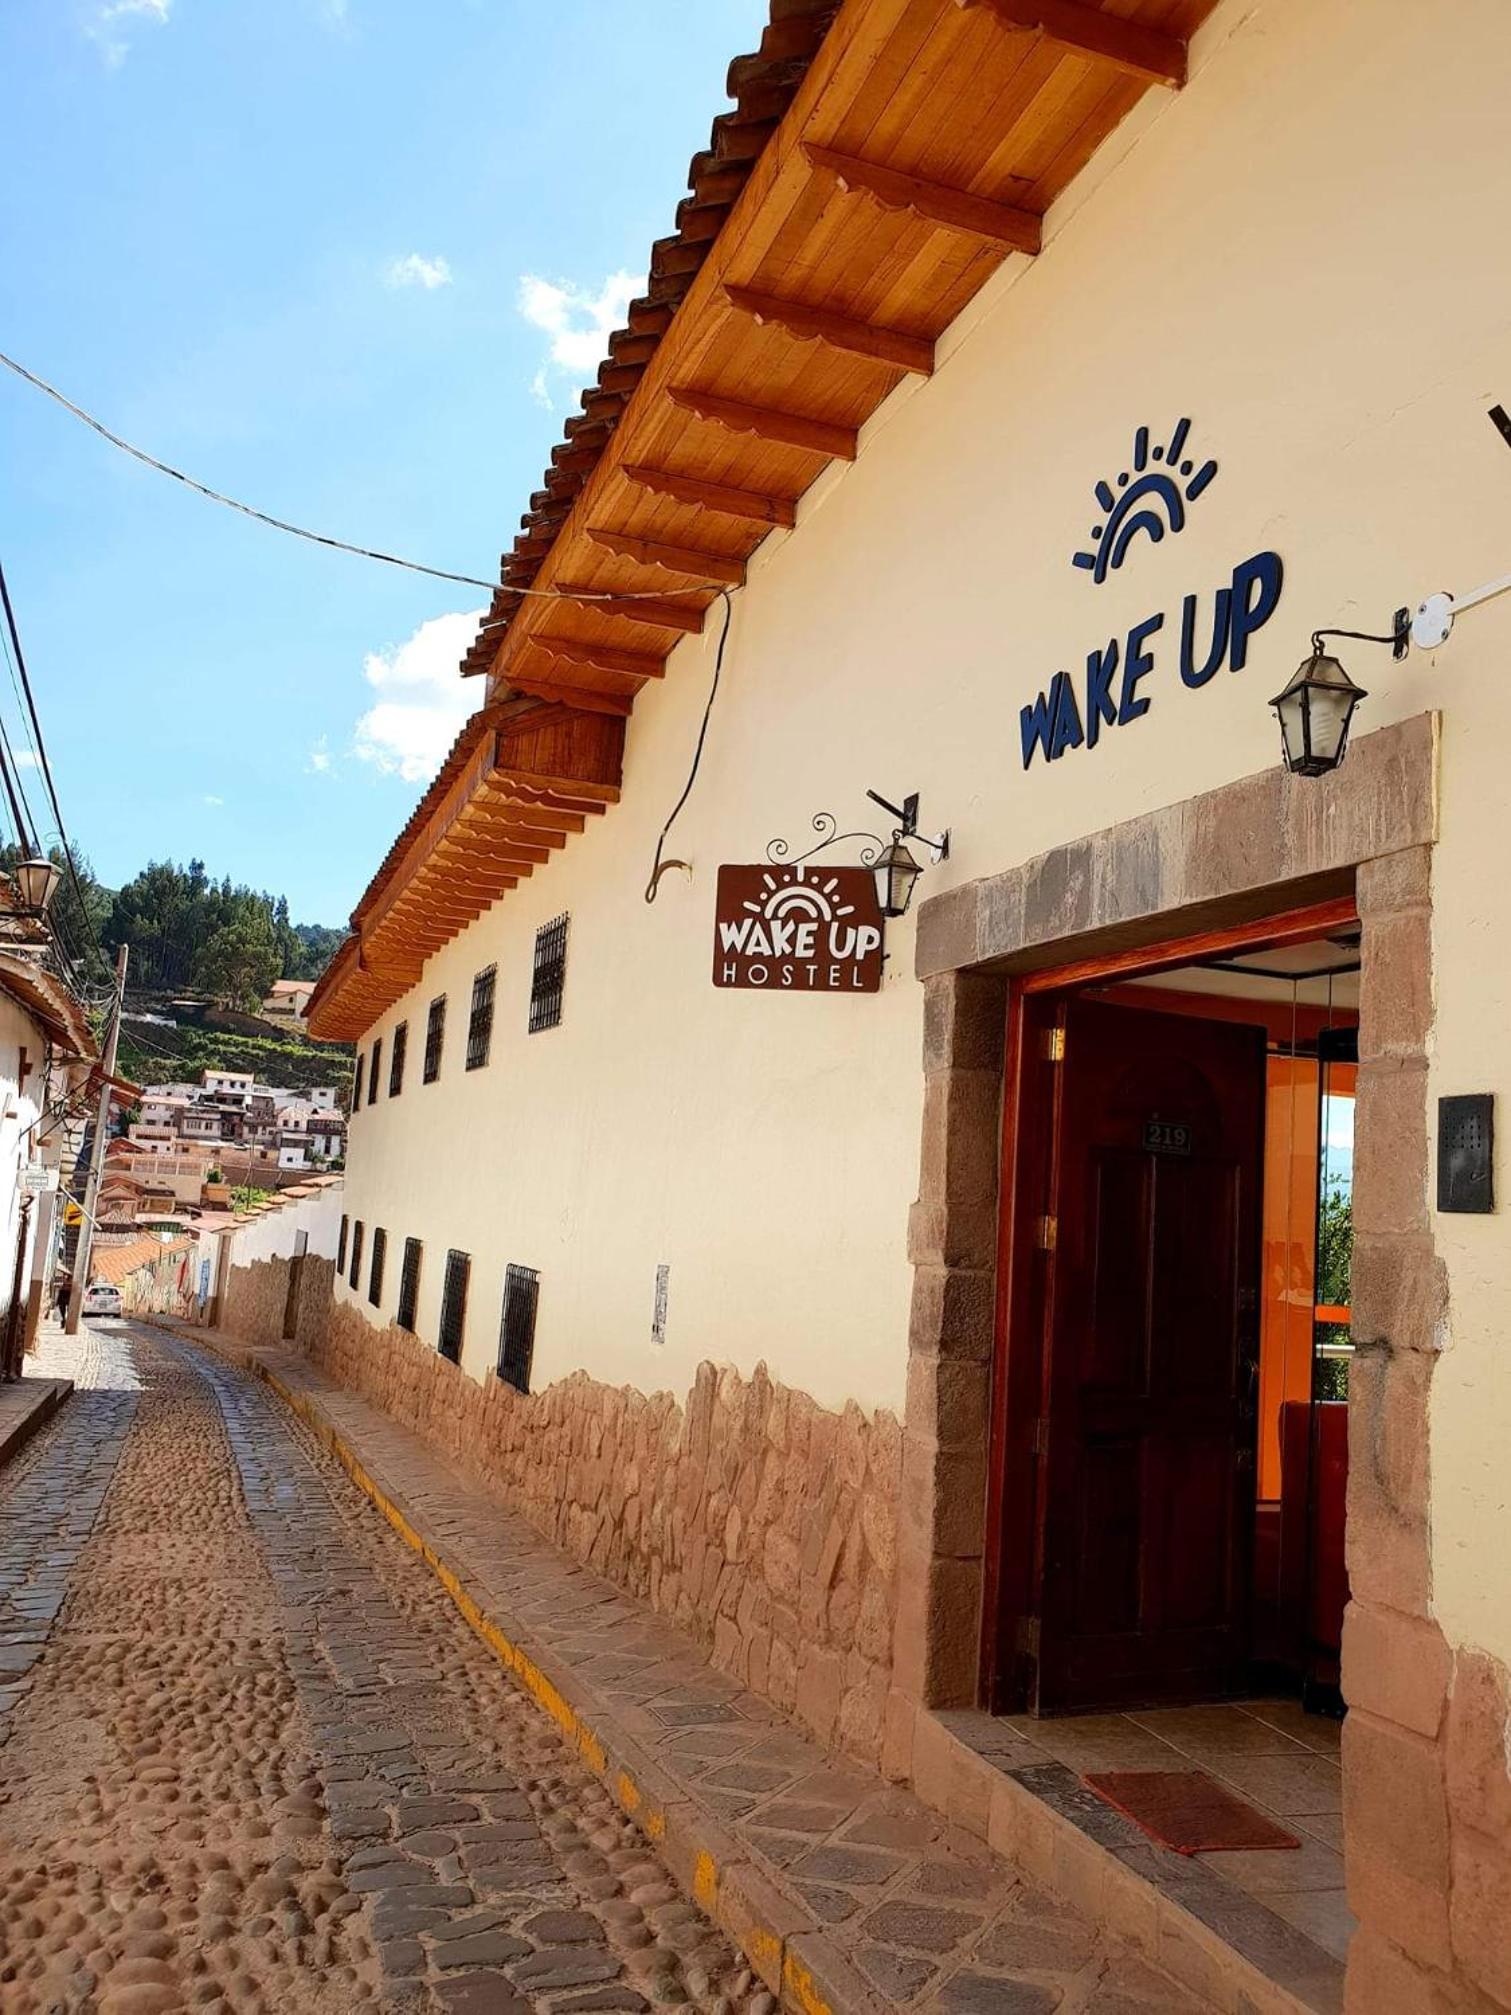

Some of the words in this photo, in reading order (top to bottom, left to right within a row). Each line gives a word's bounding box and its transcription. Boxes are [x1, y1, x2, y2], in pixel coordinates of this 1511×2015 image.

[1020, 612, 1164, 771] WAKE
[1180, 551, 1284, 689] UP
[719, 918, 819, 959] WAKE
[829, 921, 881, 960] UP
[723, 962, 864, 987] HOSTEL
[1149, 1125, 1186, 1146] 219
